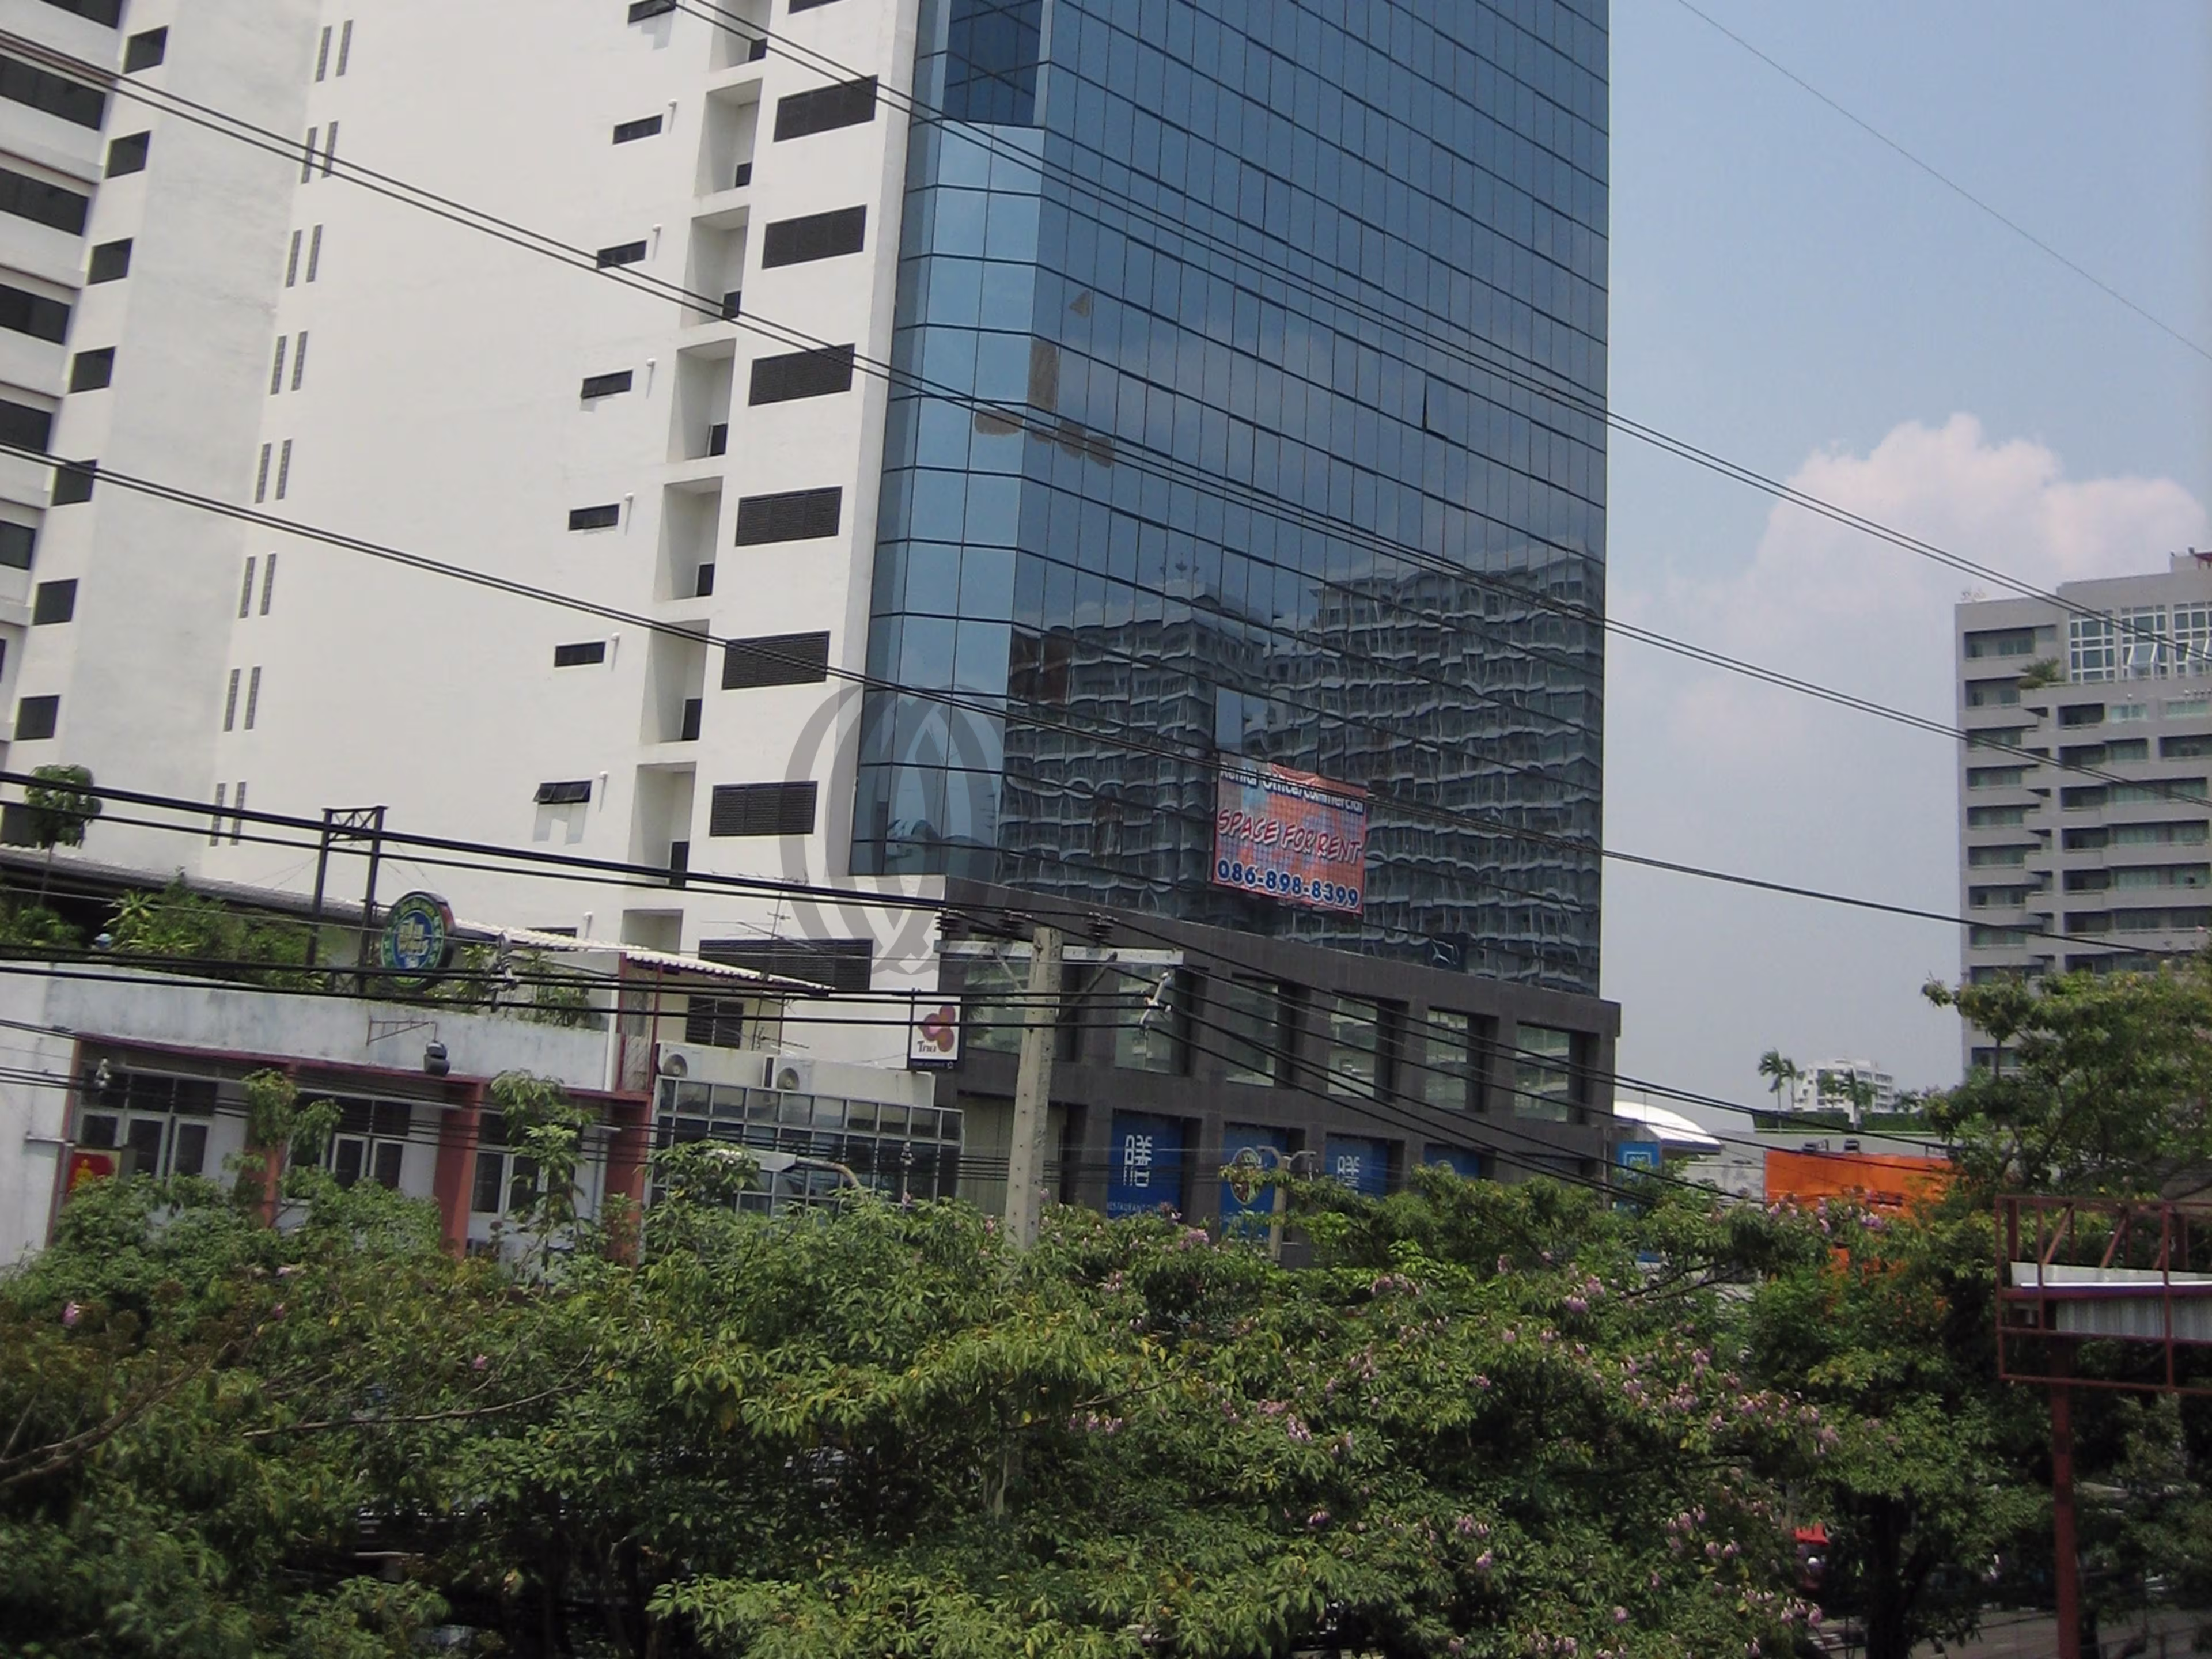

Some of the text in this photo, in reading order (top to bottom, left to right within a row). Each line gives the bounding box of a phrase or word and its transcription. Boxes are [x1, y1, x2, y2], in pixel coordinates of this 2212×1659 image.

[1218, 808, 1363, 865] SPACE FOR RENT
[1217, 859, 1359, 908] 086-898-8399
